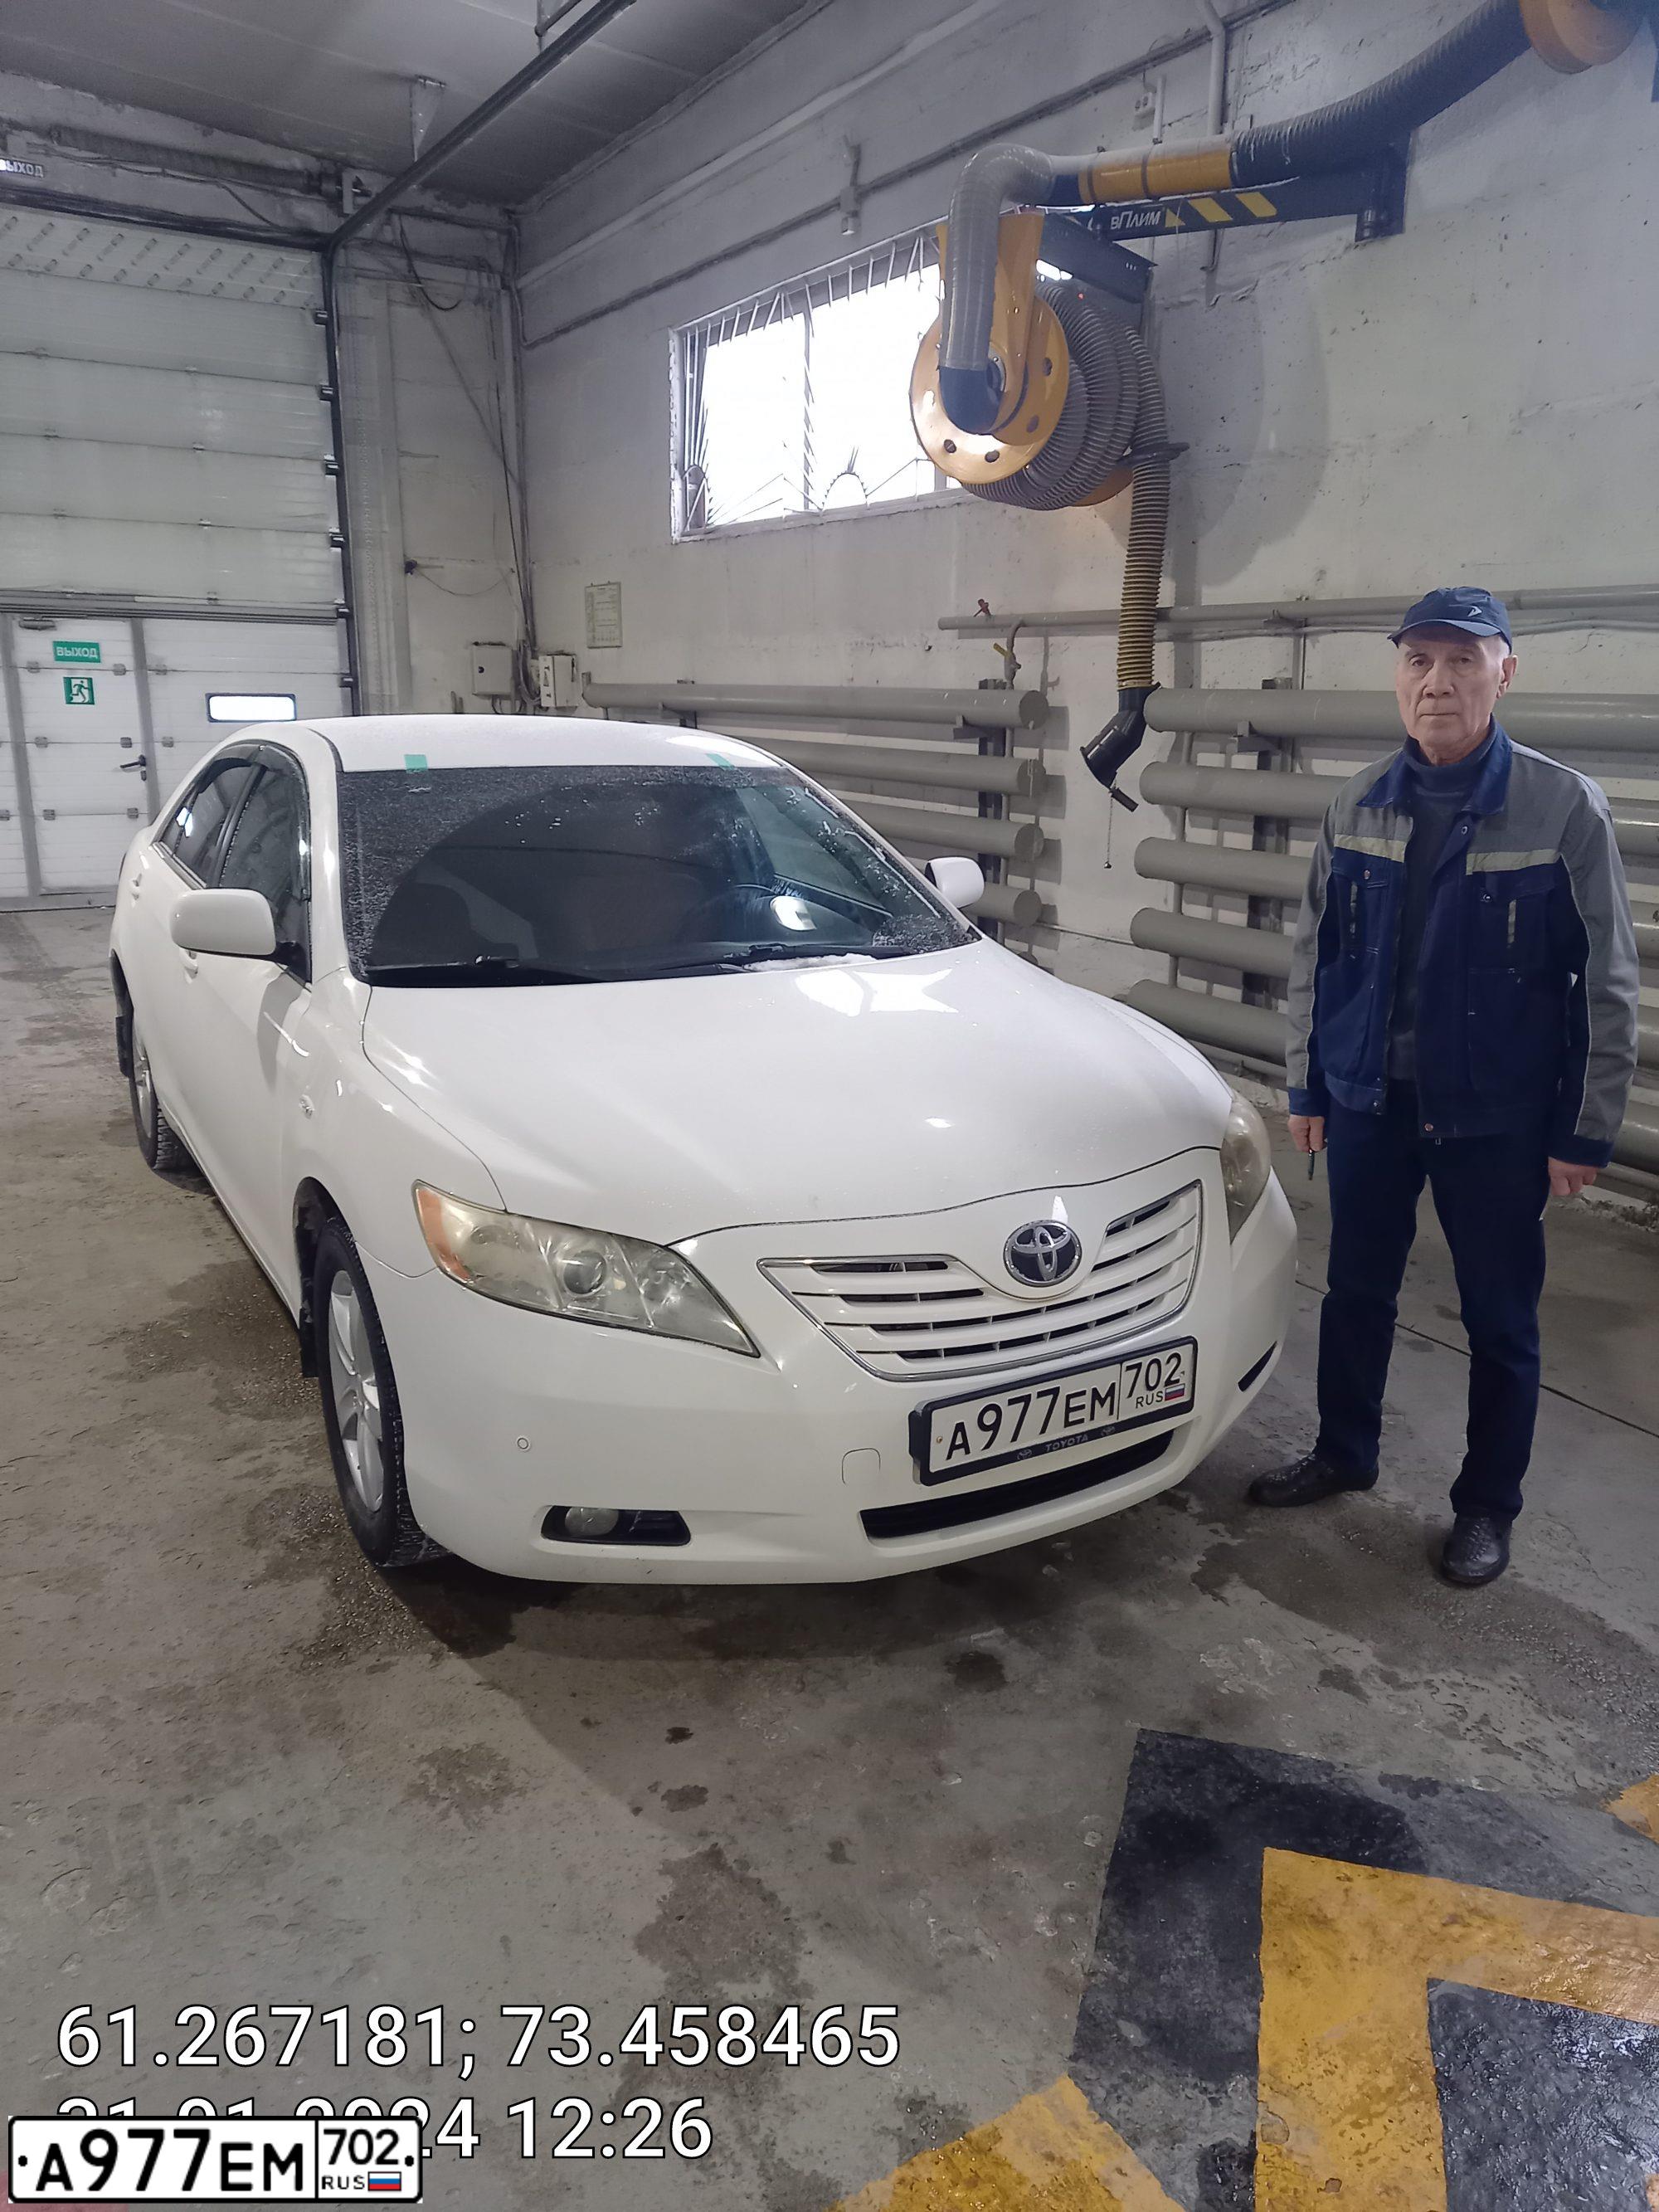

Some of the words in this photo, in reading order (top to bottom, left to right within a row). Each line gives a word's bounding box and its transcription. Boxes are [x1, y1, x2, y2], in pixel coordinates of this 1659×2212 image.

[56, 647, 98, 659] ВЫХОД
[1125, 1352, 1182, 1399] 702
[1136, 1391, 1163, 1409] RUS
[1045, 1434, 1088, 1452] TOYOTA
